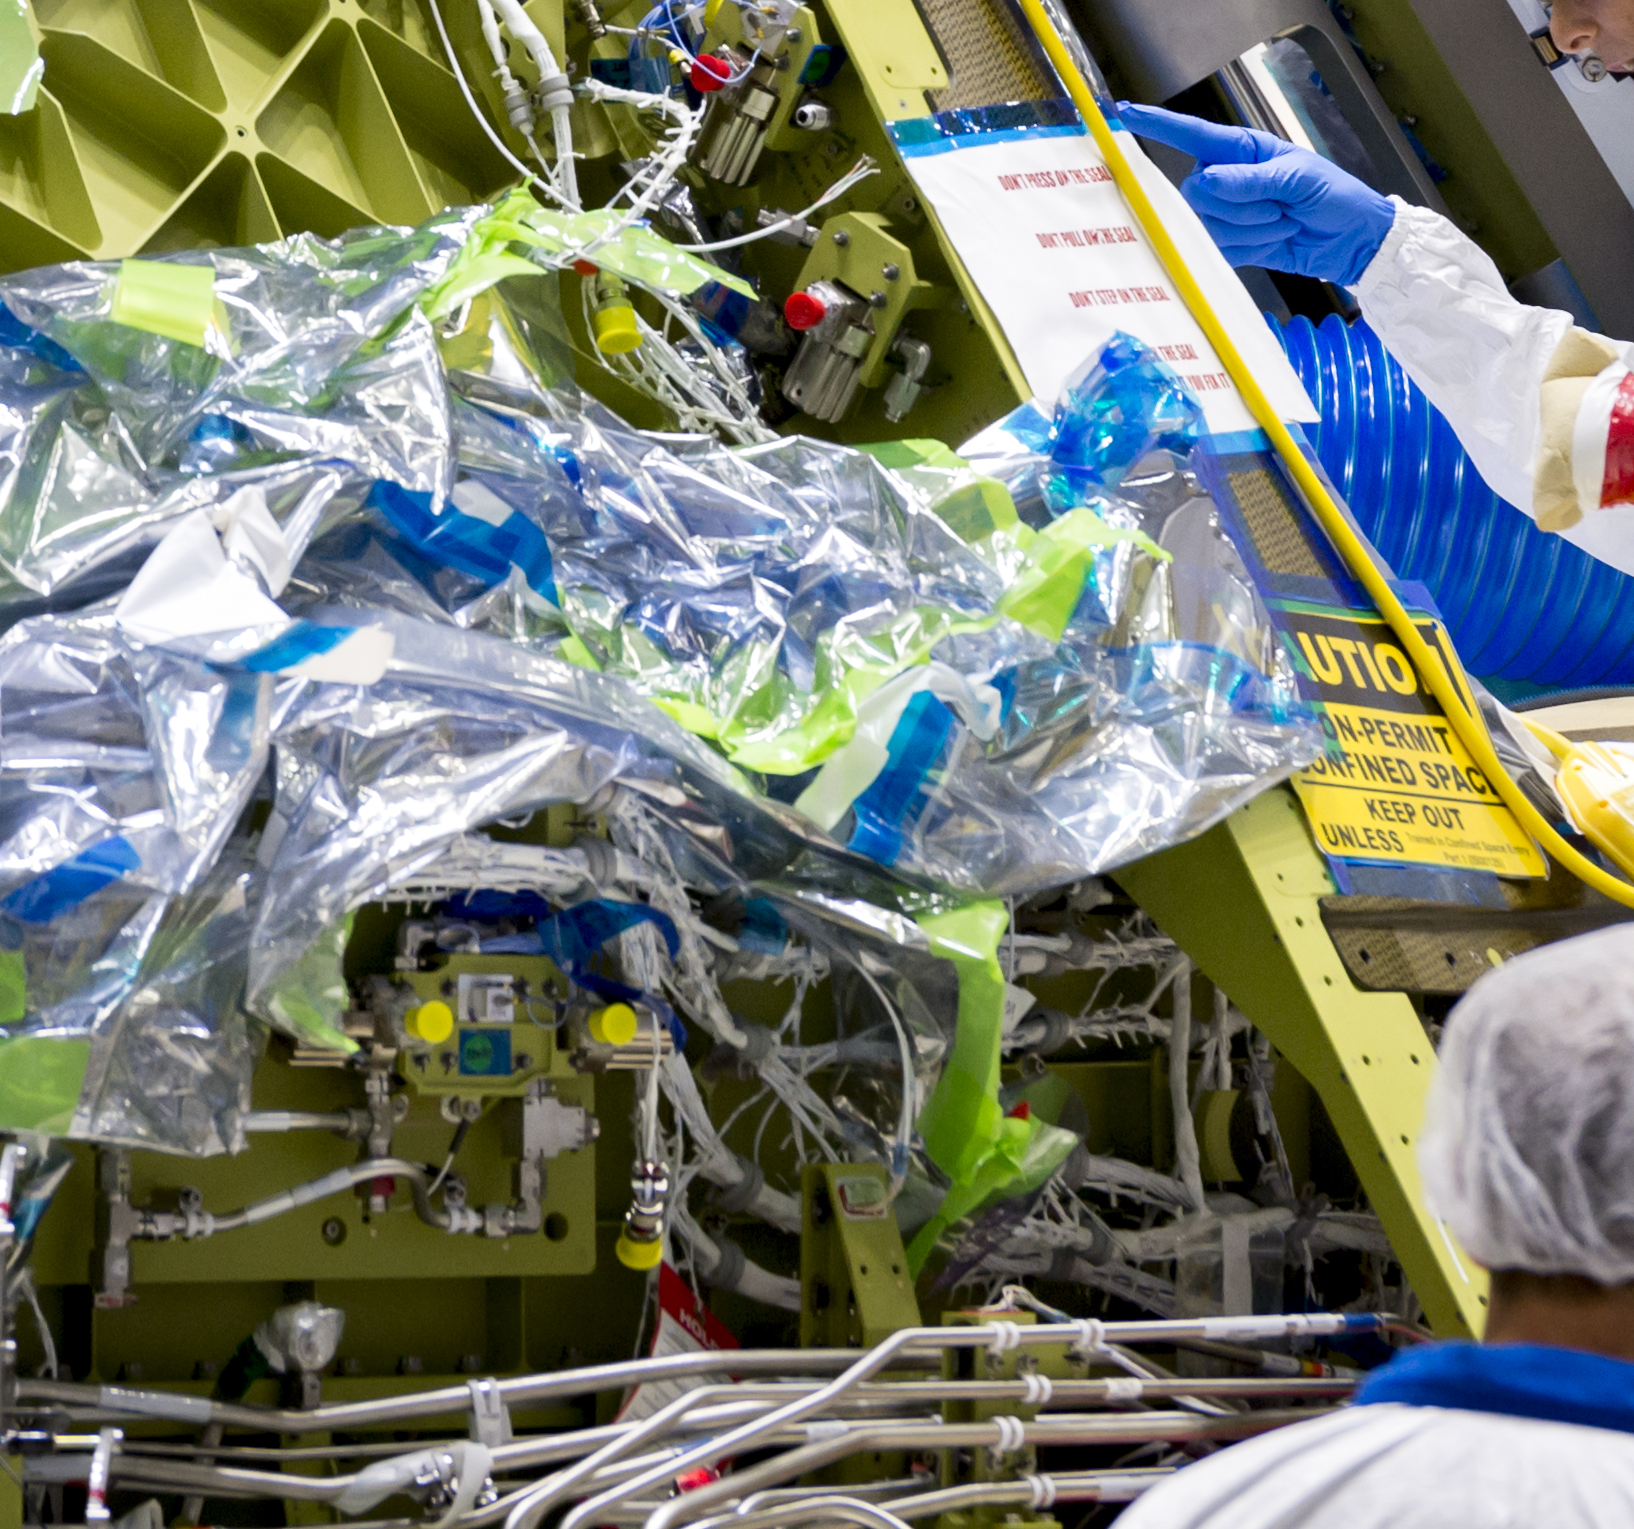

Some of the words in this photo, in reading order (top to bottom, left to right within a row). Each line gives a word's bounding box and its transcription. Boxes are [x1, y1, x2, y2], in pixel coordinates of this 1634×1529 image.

[1024, 171, 1056, 189] PRESS
[1067, 169, 1090, 184] THE
[1112, 226, 1138, 243] SEAL
[1095, 289, 1118, 305] STEP
[1129, 287, 1147, 302] THE
[1145, 285, 1171, 301] SEAL
[1158, 345, 1176, 362] THE
[1174, 344, 1199, 360] SEAL
[1188, 374, 1206, 391] YOU
[1204, 373, 1221, 390] FIX
[1219, 373, 1231, 389] IT
[1317, 711, 1454, 755] ON-PERMIT
[1301, 750, 1418, 787] ONFINED
[1419, 761, 1501, 798] SPAC
[1364, 797, 1416, 825] KEEP
[1421, 805, 1465, 832] OUT
[1321, 823, 1405, 853] UNLESS
